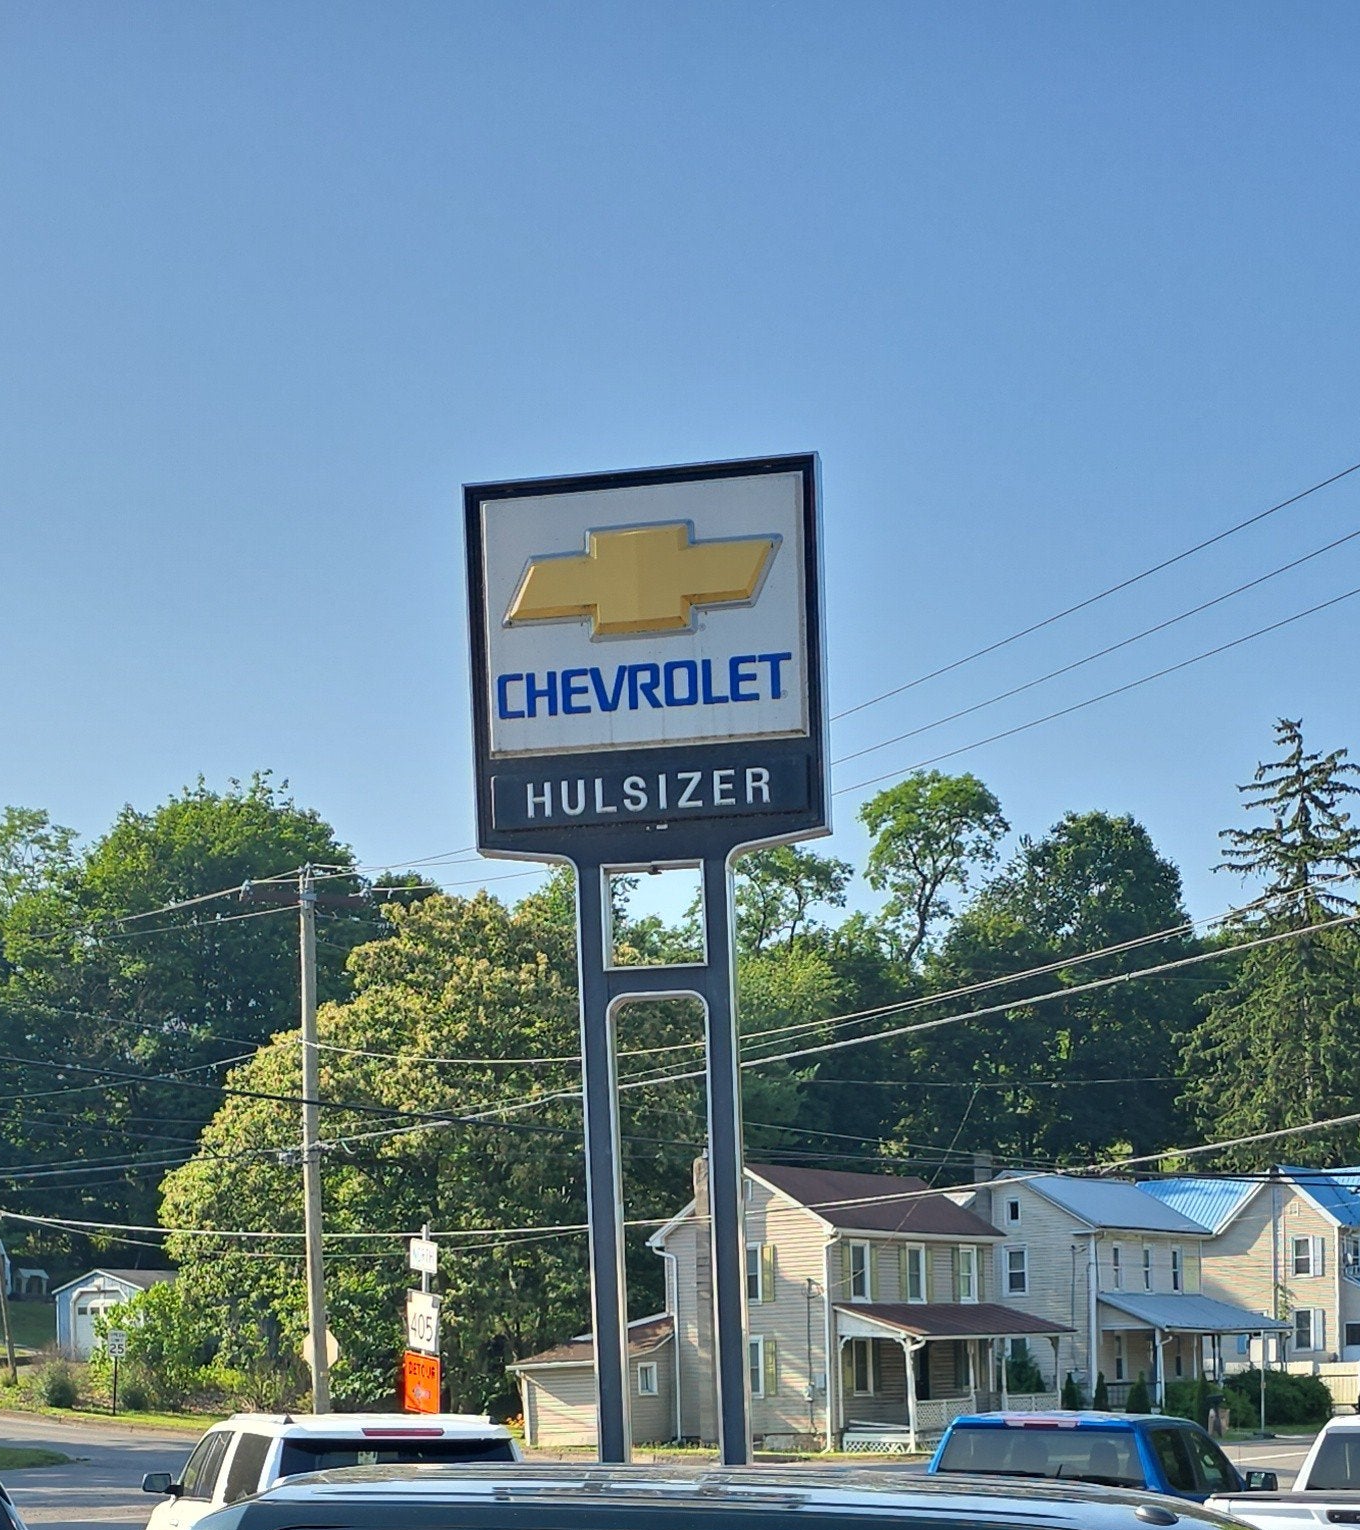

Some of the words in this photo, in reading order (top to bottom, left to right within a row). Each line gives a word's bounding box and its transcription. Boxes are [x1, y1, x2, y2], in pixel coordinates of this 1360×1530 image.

[497, 651, 792, 719] CHEVROLET
[526, 766, 772, 818] HULSIZER
[410, 1313, 434, 1342] 405
[109, 1343, 125, 1355] 25
[408, 1361, 436, 1380] DETOUR
